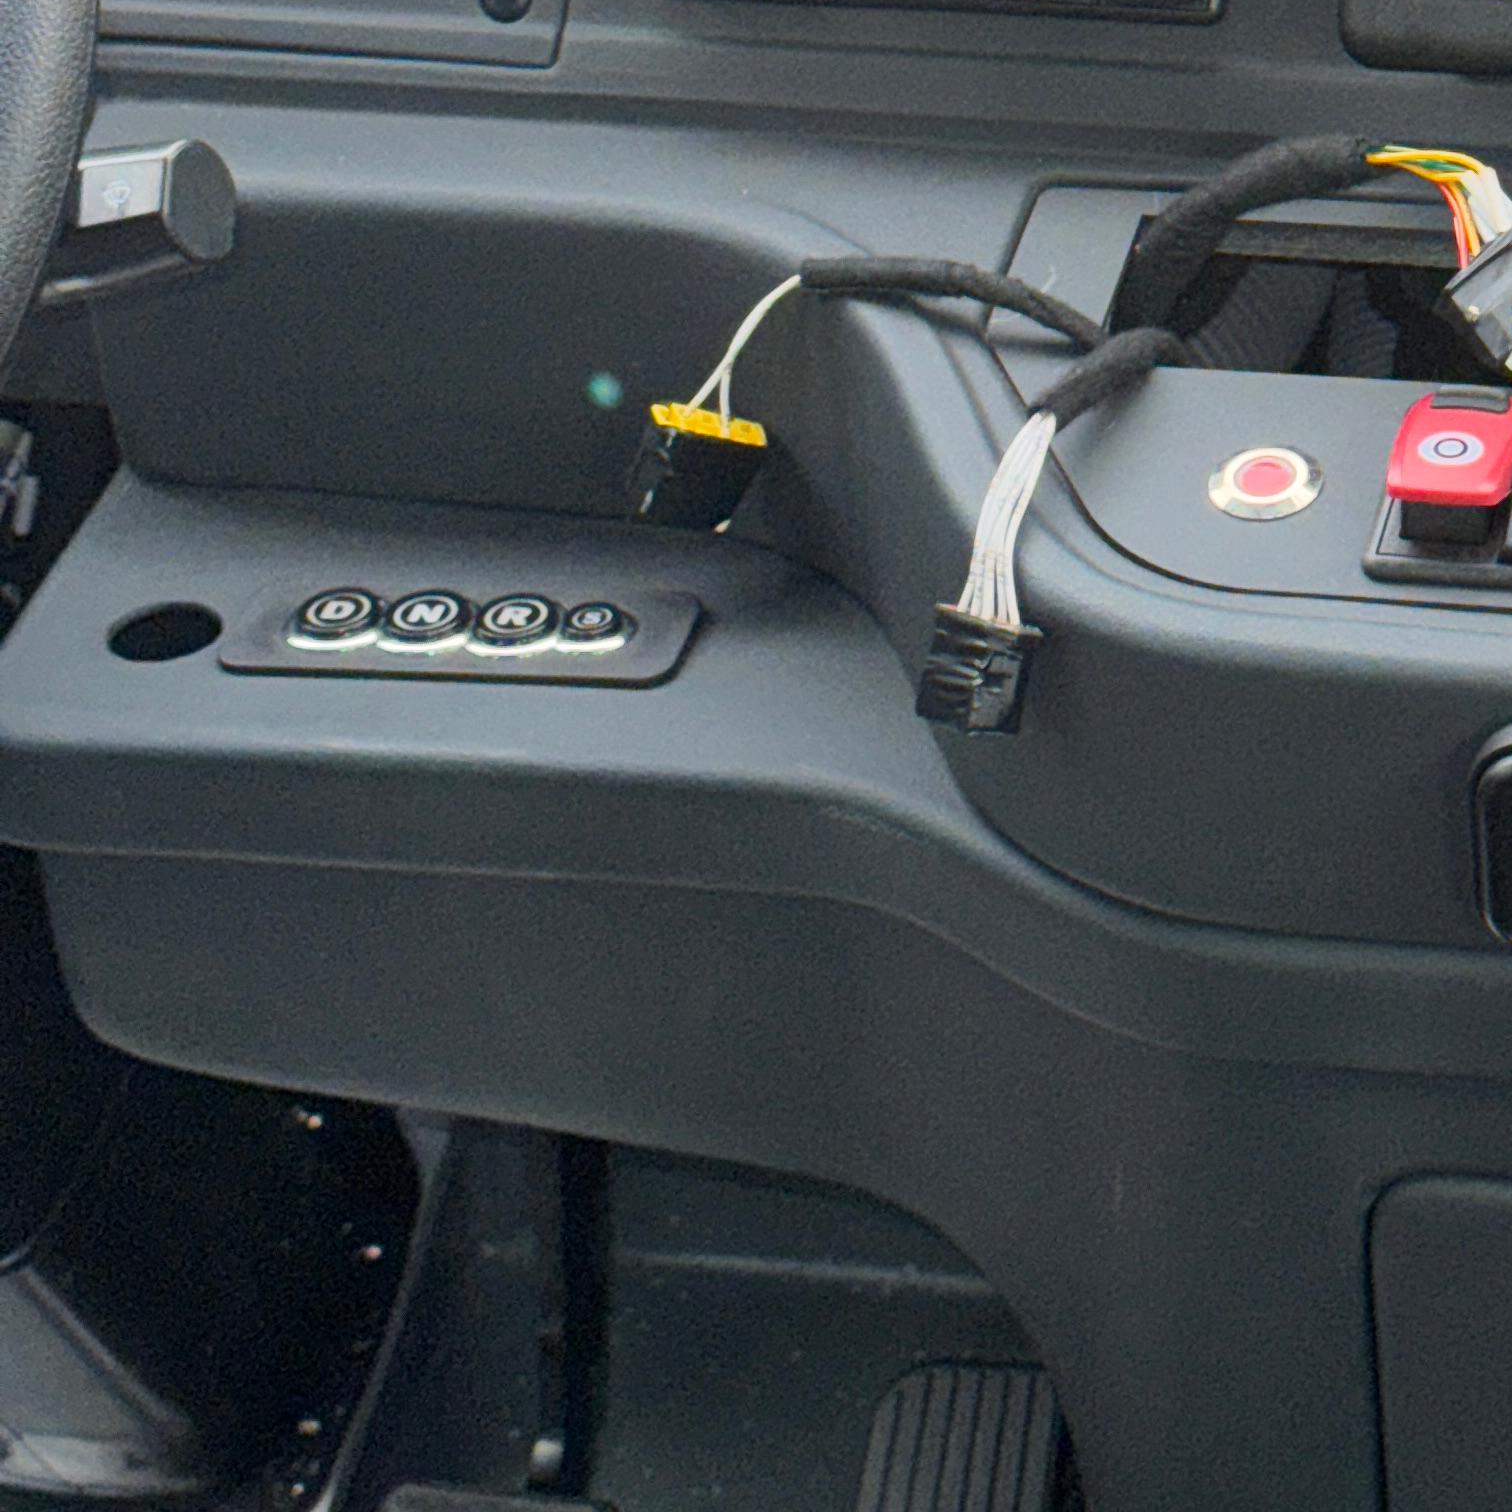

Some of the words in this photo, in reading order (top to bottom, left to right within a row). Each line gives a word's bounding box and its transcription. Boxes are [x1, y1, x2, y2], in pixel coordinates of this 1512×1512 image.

[322, 601, 356, 620] D
[409, 606, 448, 623] N
[498, 607, 533, 626] R
